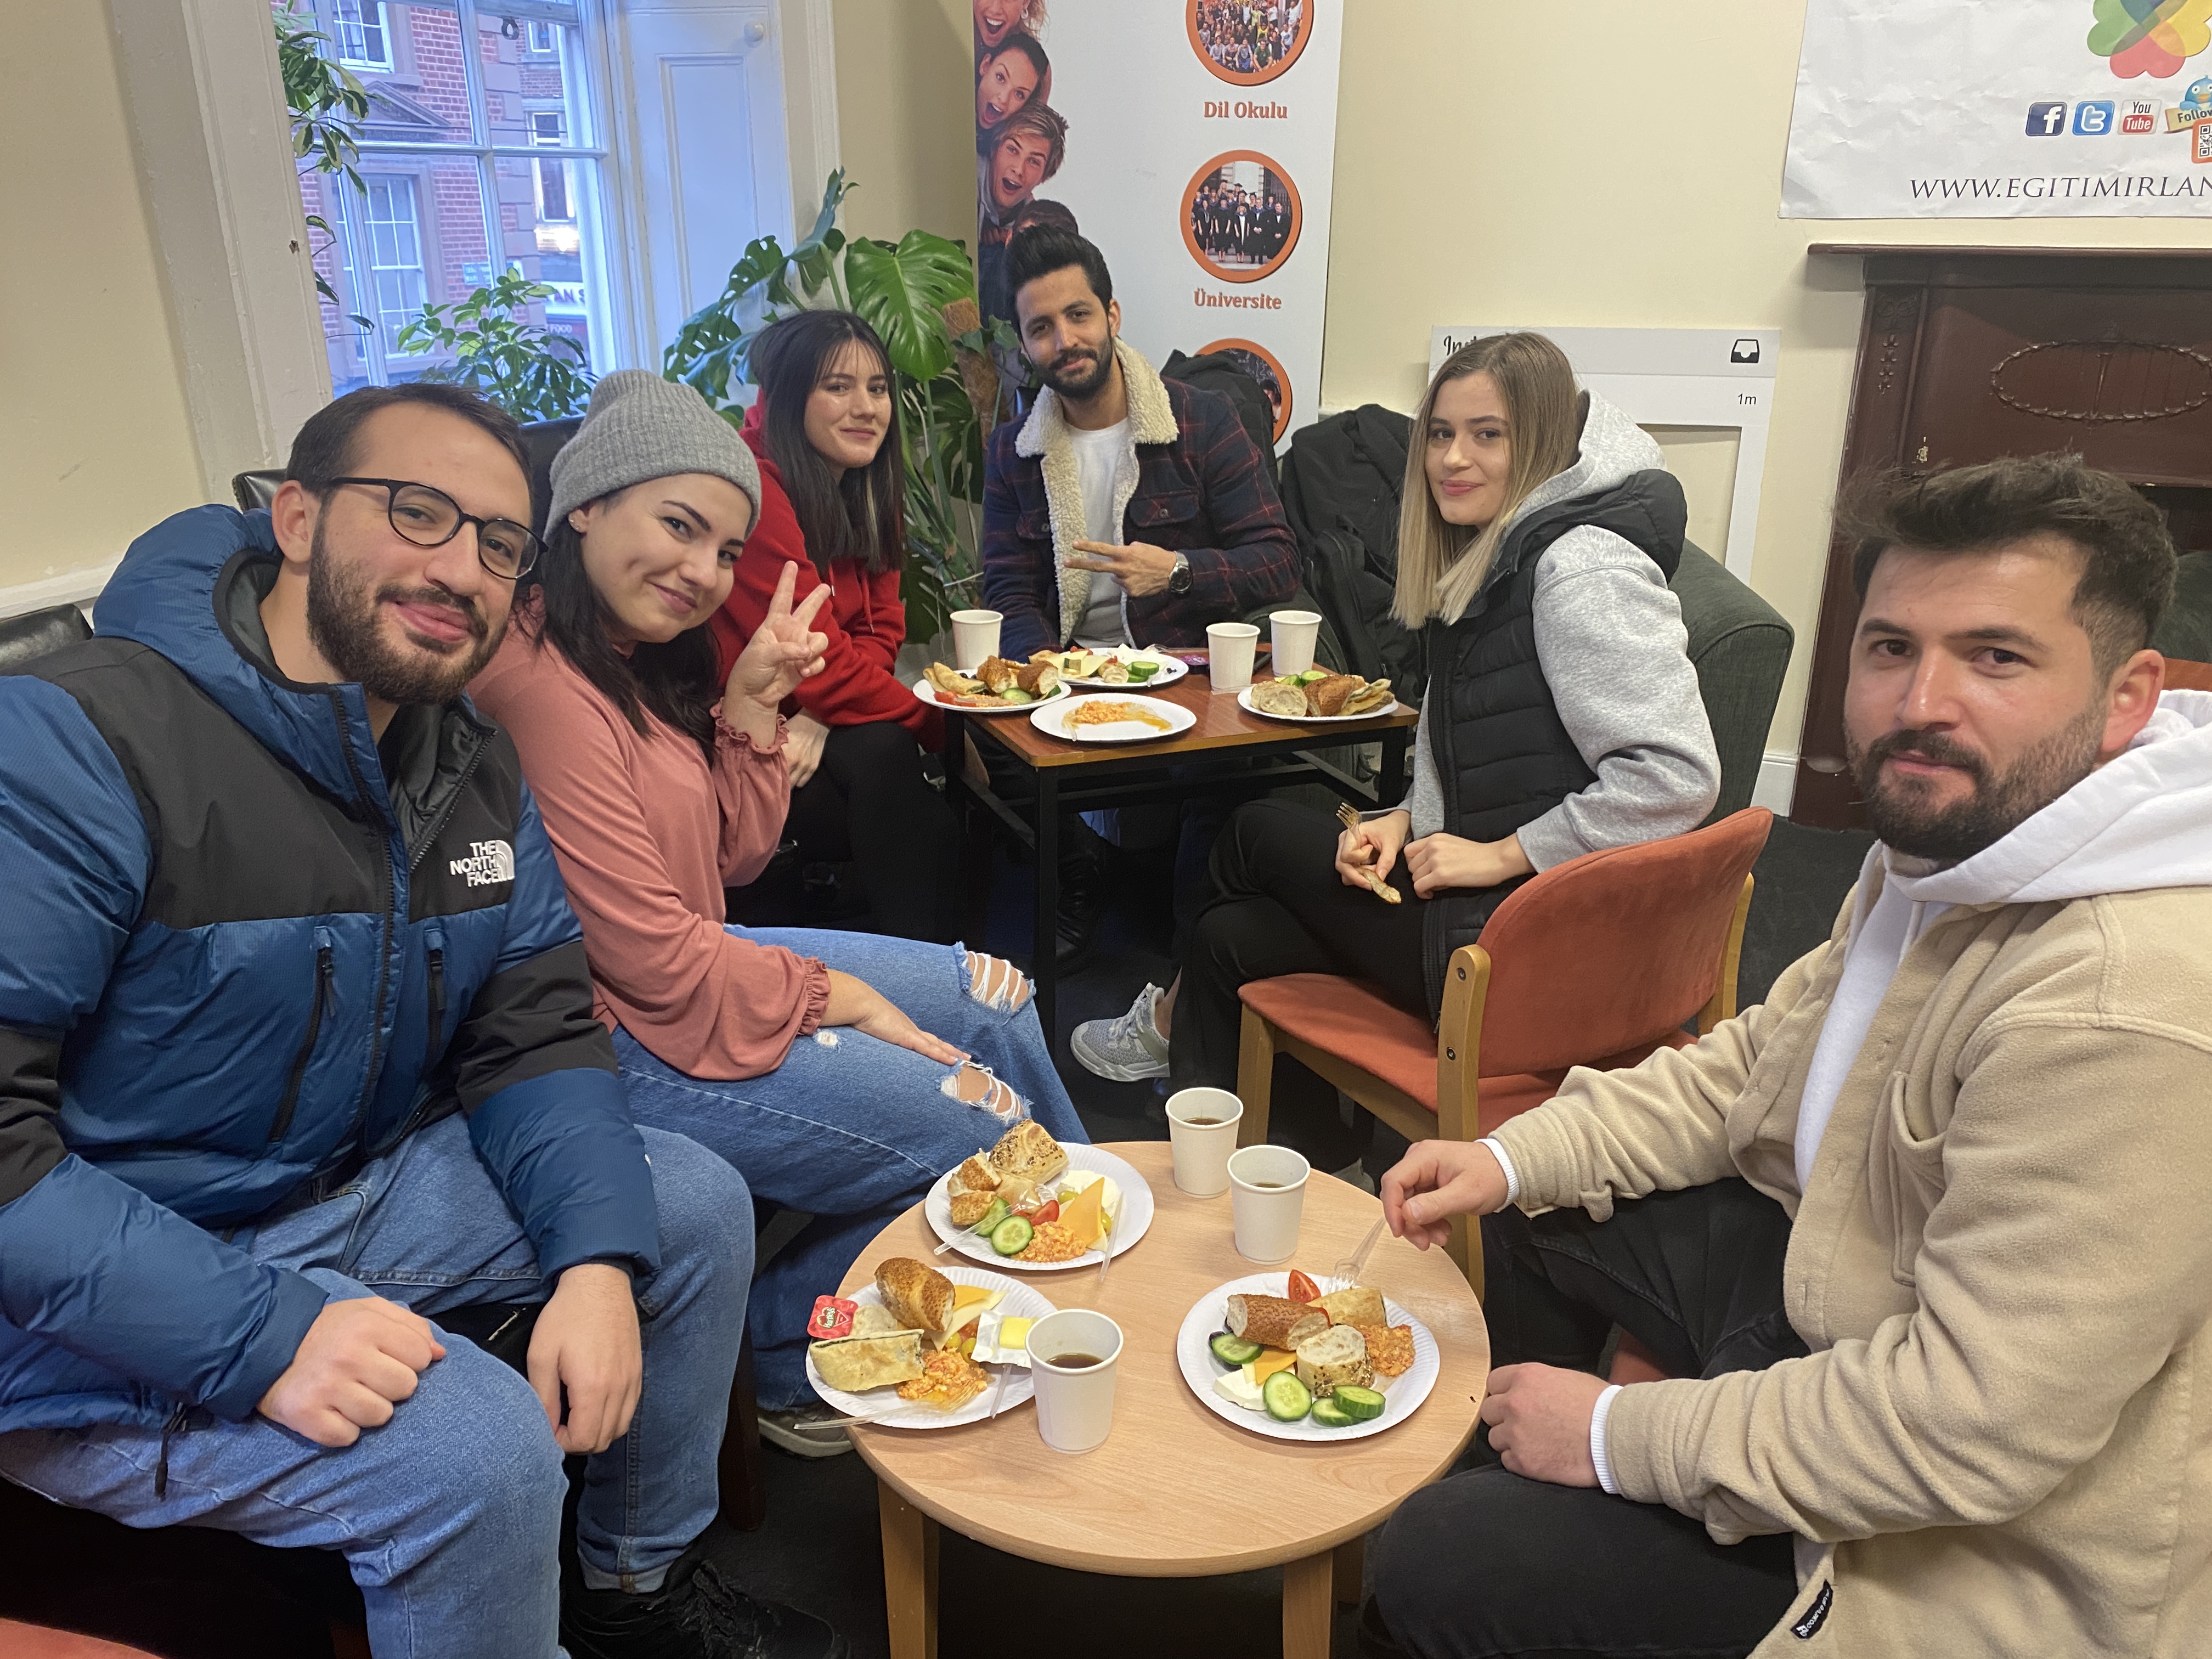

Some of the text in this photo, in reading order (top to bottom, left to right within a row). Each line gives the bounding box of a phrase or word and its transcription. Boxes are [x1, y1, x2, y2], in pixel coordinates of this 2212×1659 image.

[1204, 101, 1288, 119] Dil Okulu
[2133, 101, 2152, 114] You
[2126, 117, 2151, 131] Tube
[1194, 287, 1282, 309] Üniversite
[1737, 393, 1757, 405] 1m
[470, 840, 496, 856] THE
[449, 855, 496, 875] NORTH
[467, 868, 499, 887] FACE
